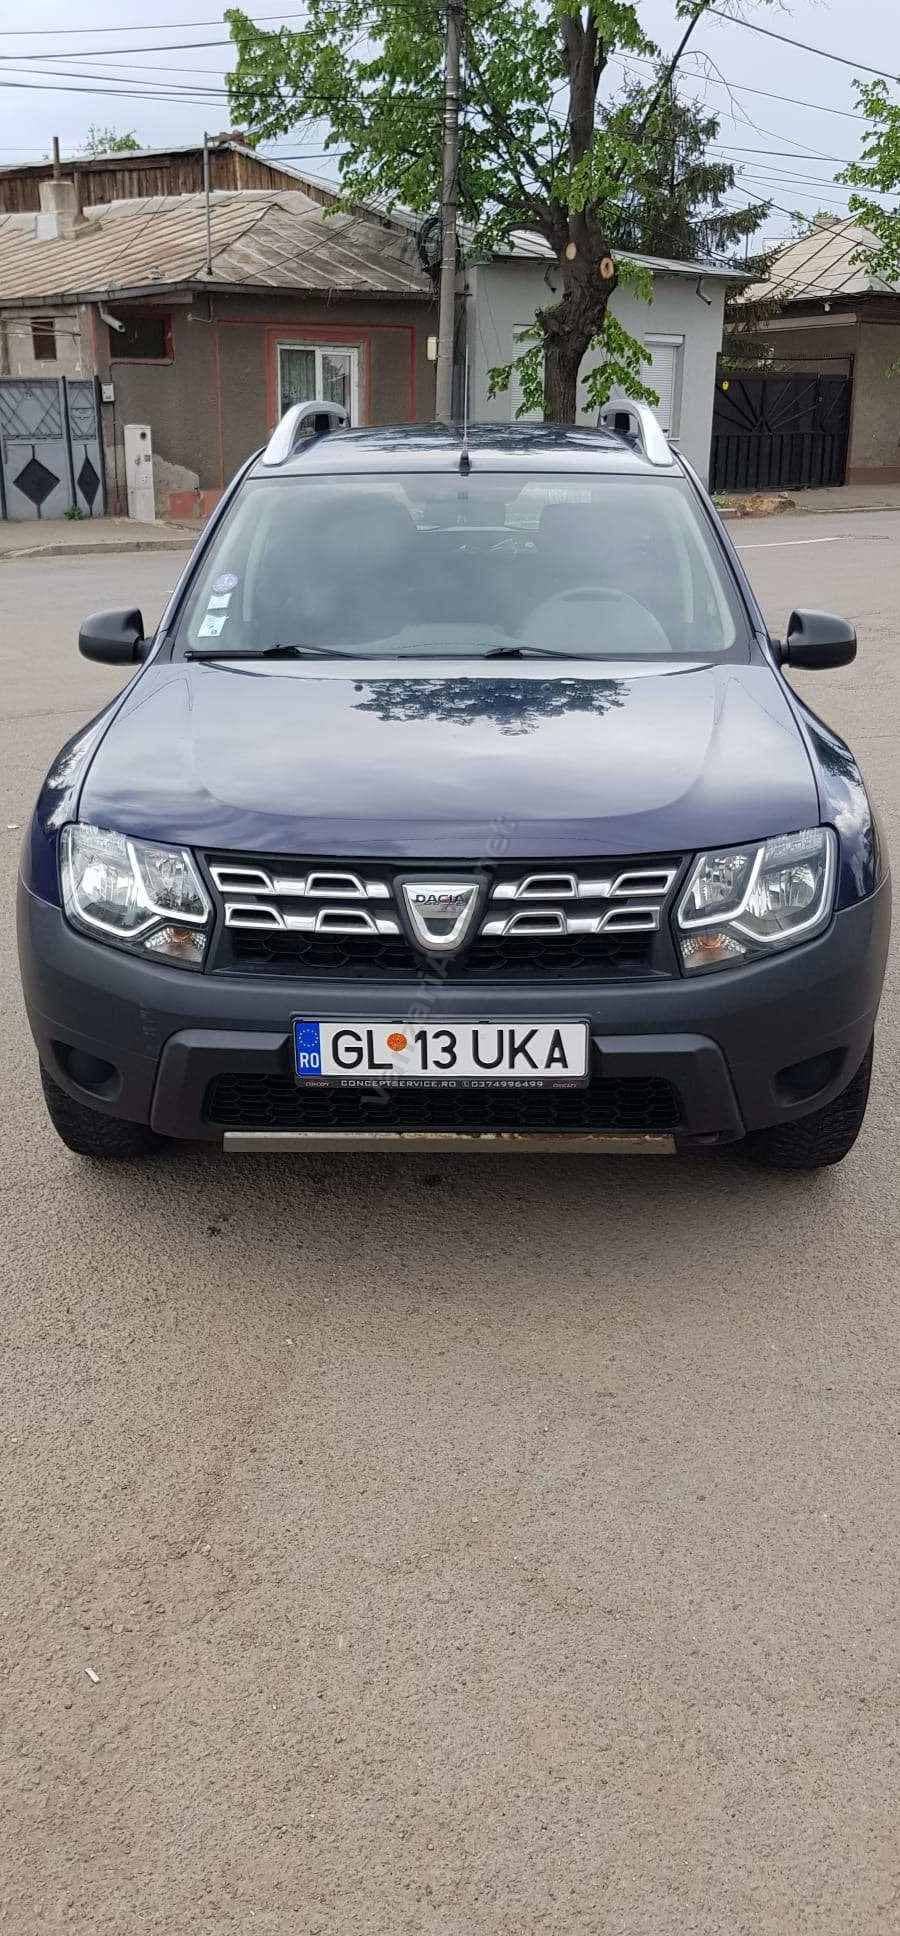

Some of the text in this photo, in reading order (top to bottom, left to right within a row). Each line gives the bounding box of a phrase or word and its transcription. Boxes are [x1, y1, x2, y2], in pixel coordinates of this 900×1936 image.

[415, 894, 465, 904] DACIA
[332, 1029, 569, 1070] GL 13 UKA
[300, 1053, 320, 1068] RO
[341, 1080, 457, 1088] CONCEPTSERVICE.RO
